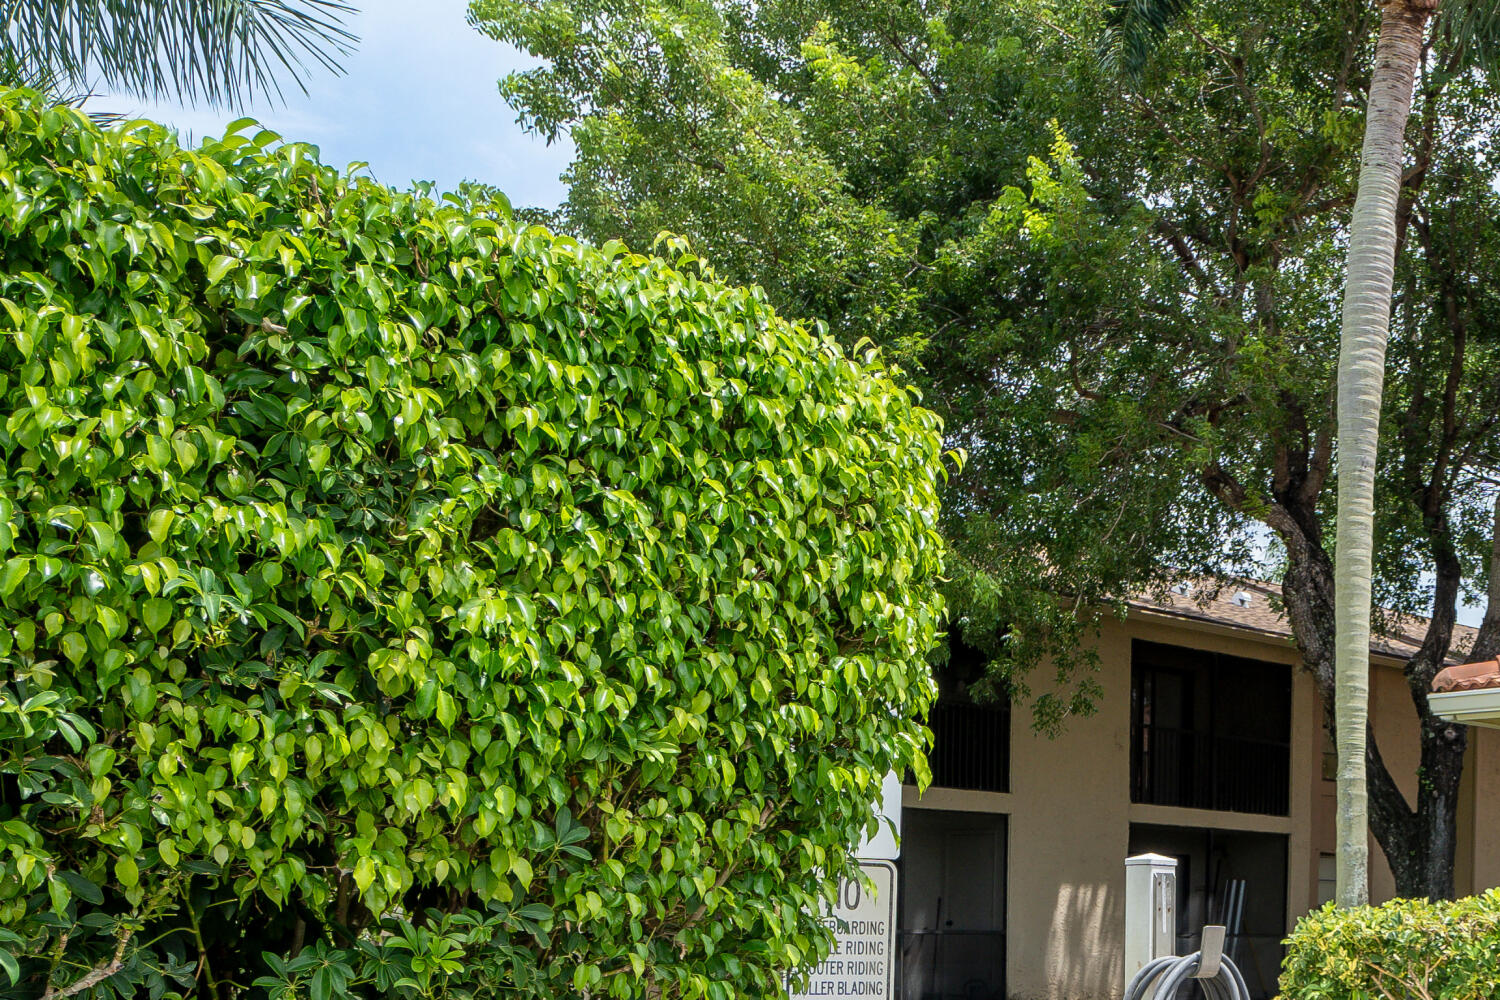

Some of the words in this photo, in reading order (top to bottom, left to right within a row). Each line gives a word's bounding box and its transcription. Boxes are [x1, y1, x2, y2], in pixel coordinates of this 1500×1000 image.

[846, 941, 884, 955] RIDING
[808, 961, 844, 976] OOTER
[847, 961, 884, 975] RIDING
[793, 981, 834, 996] OLLER
[837, 981, 883, 996] BLADING
